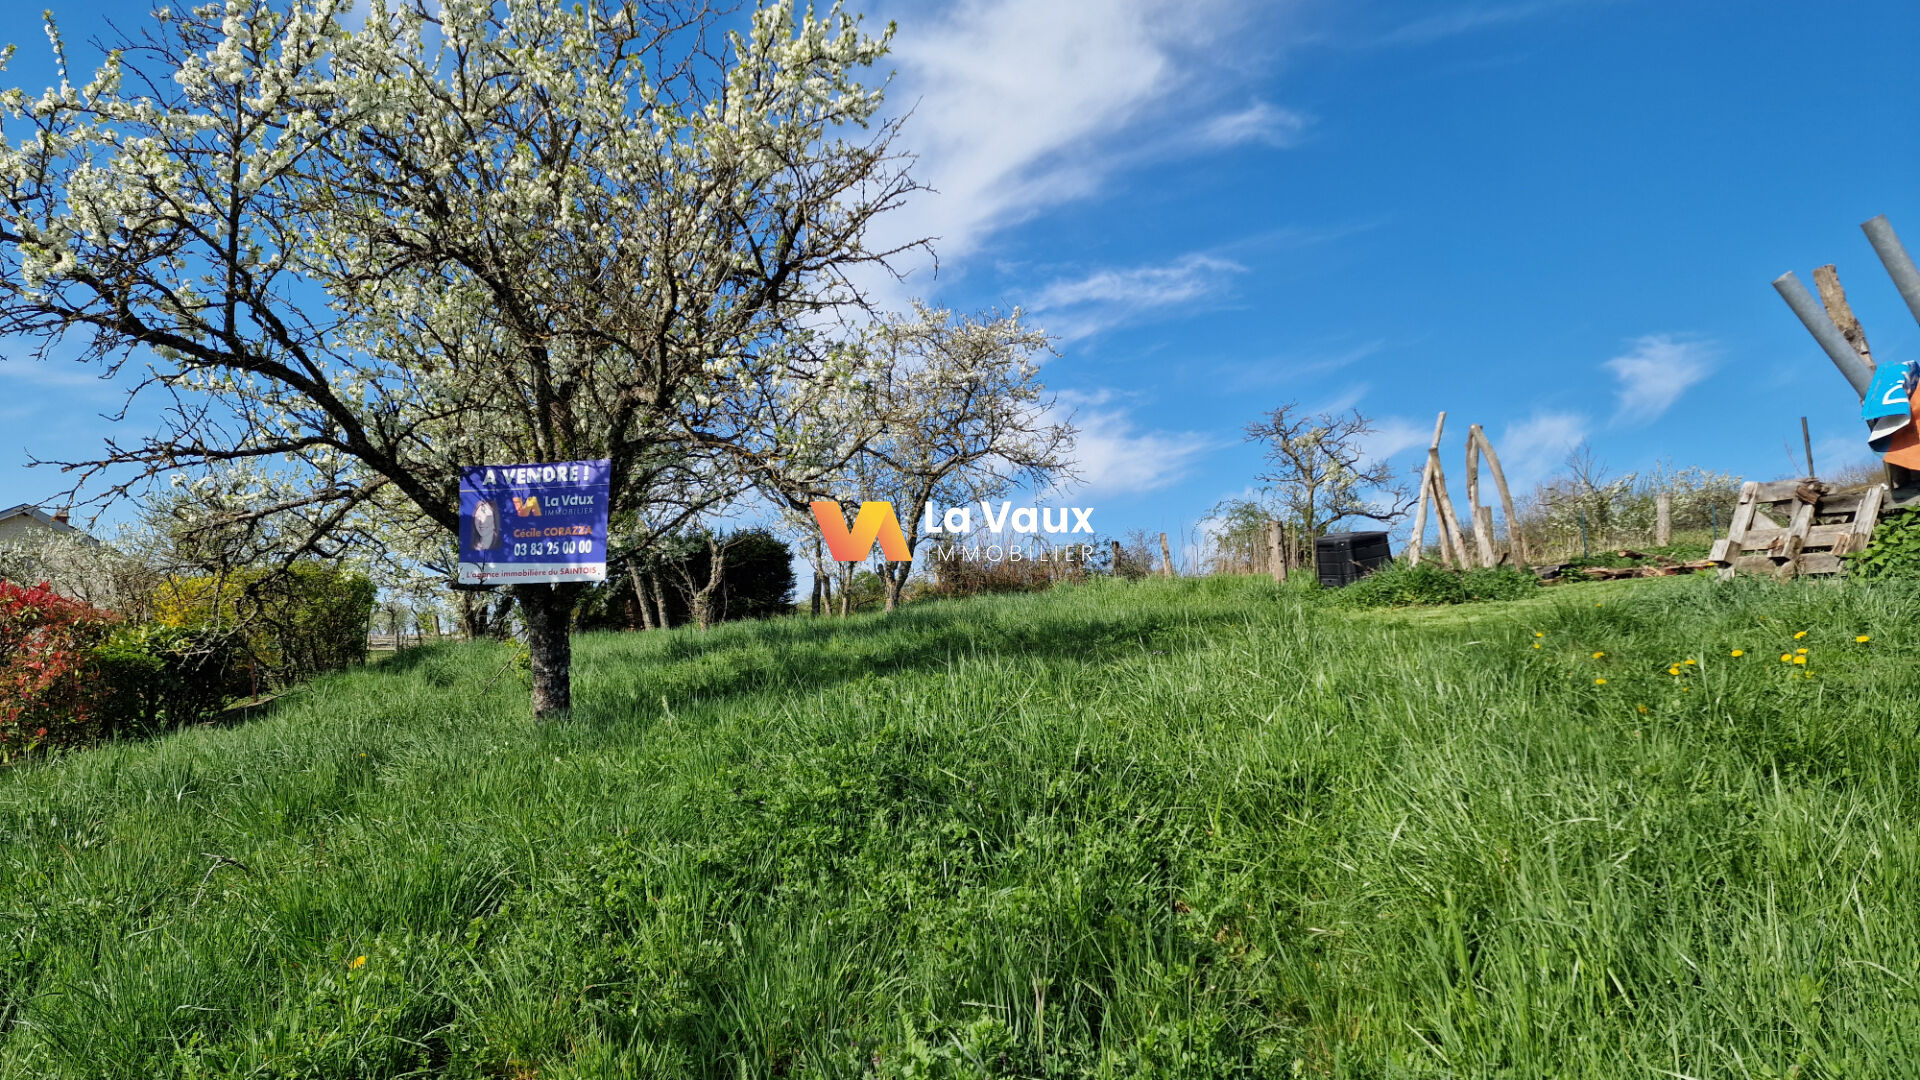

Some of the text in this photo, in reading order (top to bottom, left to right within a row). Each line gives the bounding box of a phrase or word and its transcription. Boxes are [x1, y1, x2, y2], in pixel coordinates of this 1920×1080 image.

[483, 469, 496, 485] A
[503, 465, 579, 484] VENDRE
[545, 494, 594, 507] La Vaux
[545, 507, 593, 516] IMMOBILIER
[513, 525, 592, 538] Cécile CORAZZA
[514, 539, 592, 556] 03 83 25 00 00
[501, 567, 546, 577] immobilière
[548, 567, 558, 576] du
[560, 566, 597, 575] SAINTOIS
